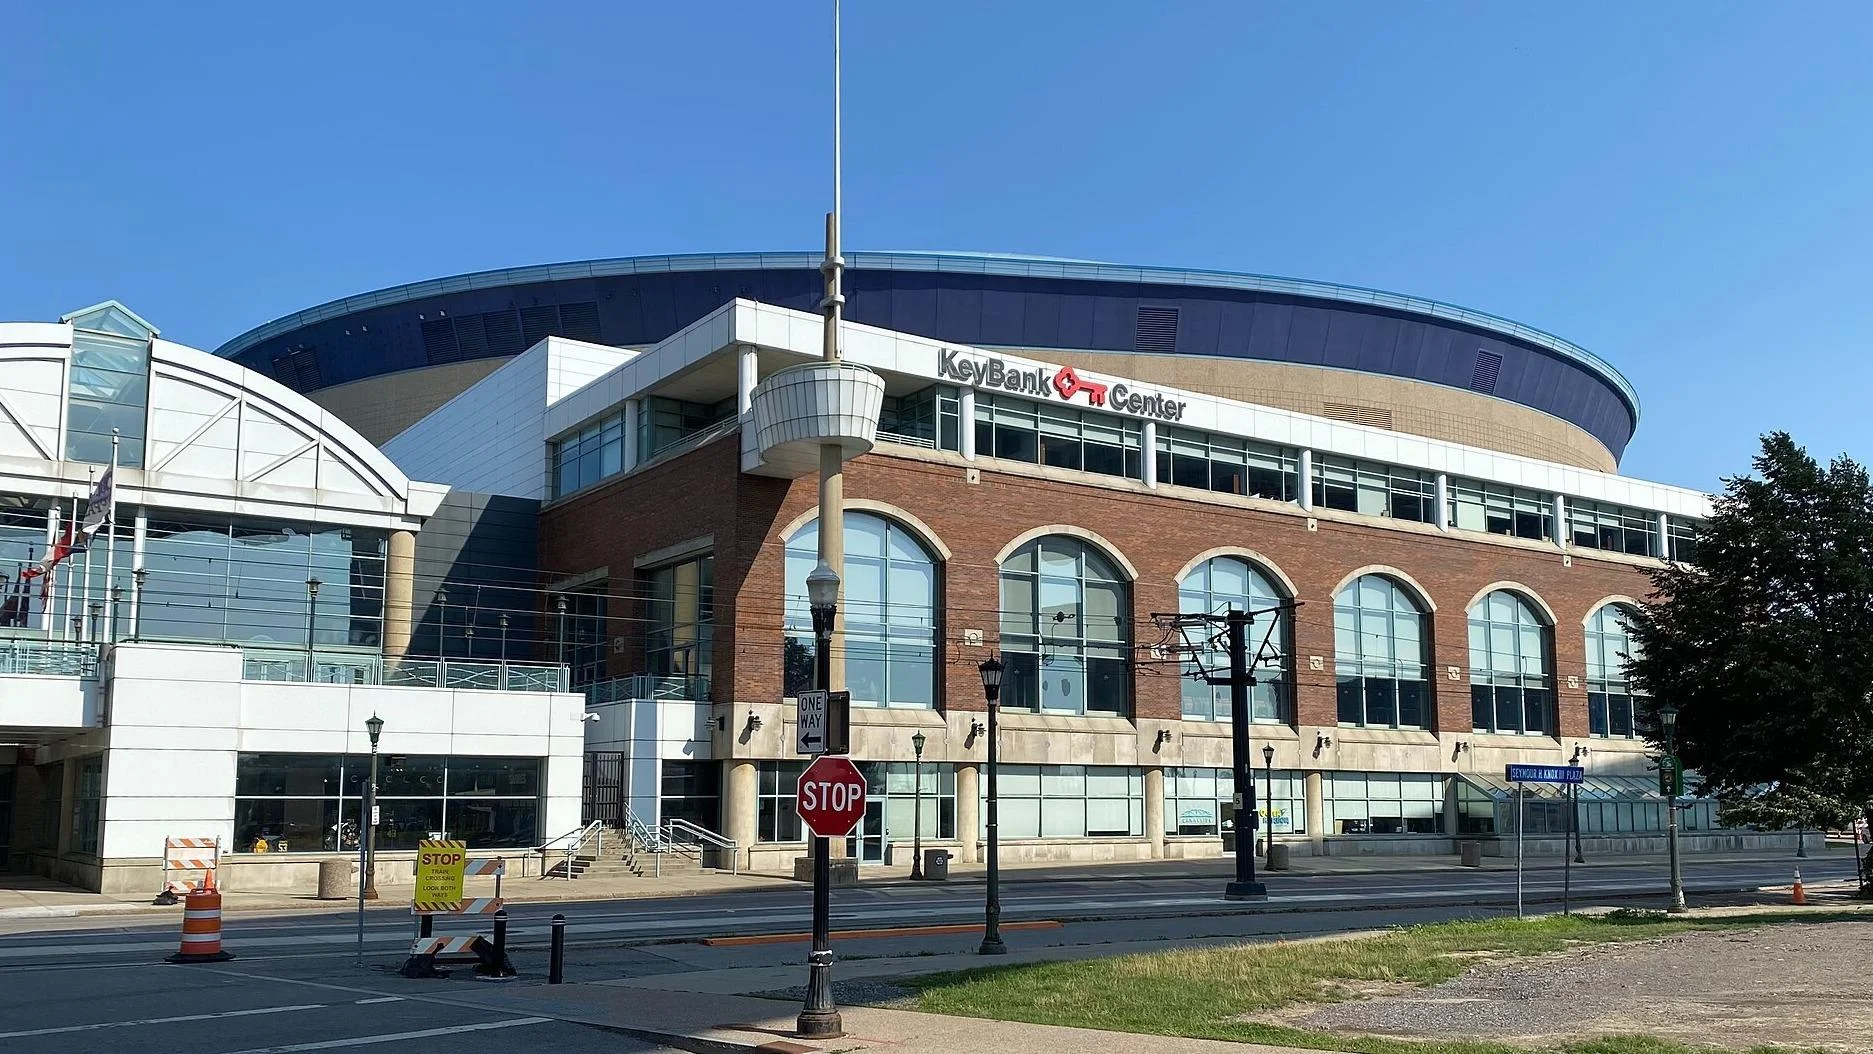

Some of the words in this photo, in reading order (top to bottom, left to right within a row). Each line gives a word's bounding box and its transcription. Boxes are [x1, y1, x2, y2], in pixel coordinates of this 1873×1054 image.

[938, 348, 1052, 397] KeyBank
[1109, 383, 1186, 421] Center
[801, 696, 822, 711] ONE
[800, 714, 822, 729] WAY
[1544, 769, 1558, 780] KNOX
[1566, 770, 1583, 780] PLAZA
[802, 781, 862, 812] STOP
[1235, 797, 1240, 805] 5
[422, 853, 462, 866] STOP
